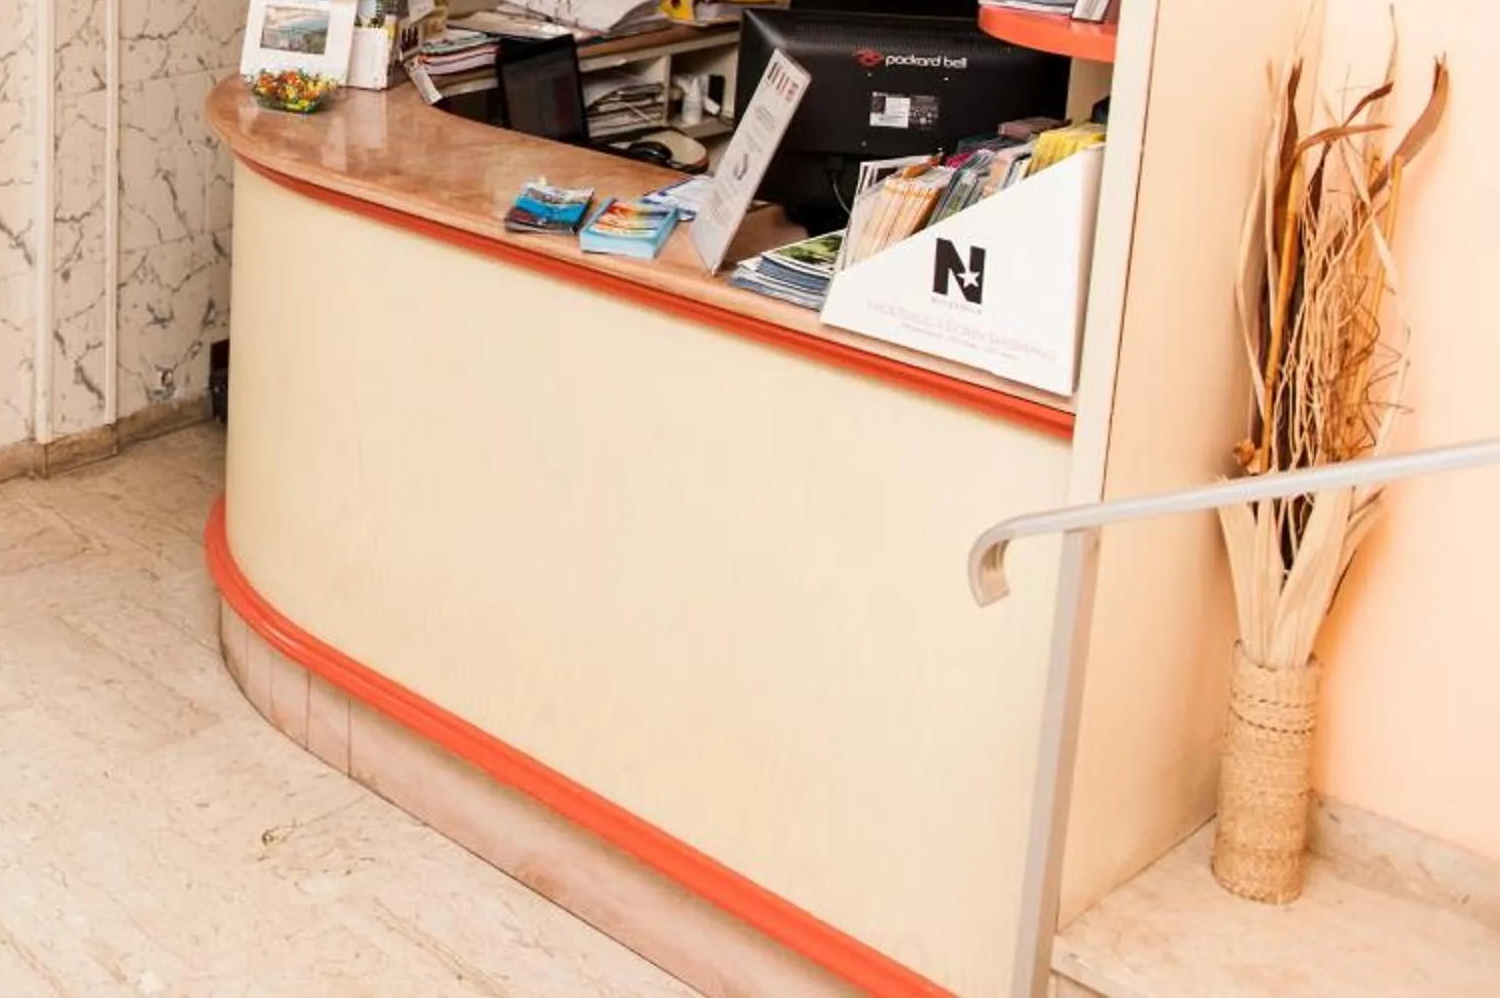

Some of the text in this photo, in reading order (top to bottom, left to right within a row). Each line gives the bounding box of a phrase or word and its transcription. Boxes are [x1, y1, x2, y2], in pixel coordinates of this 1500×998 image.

[885, 53, 967, 69] packard bell
[932, 237, 986, 304] N
